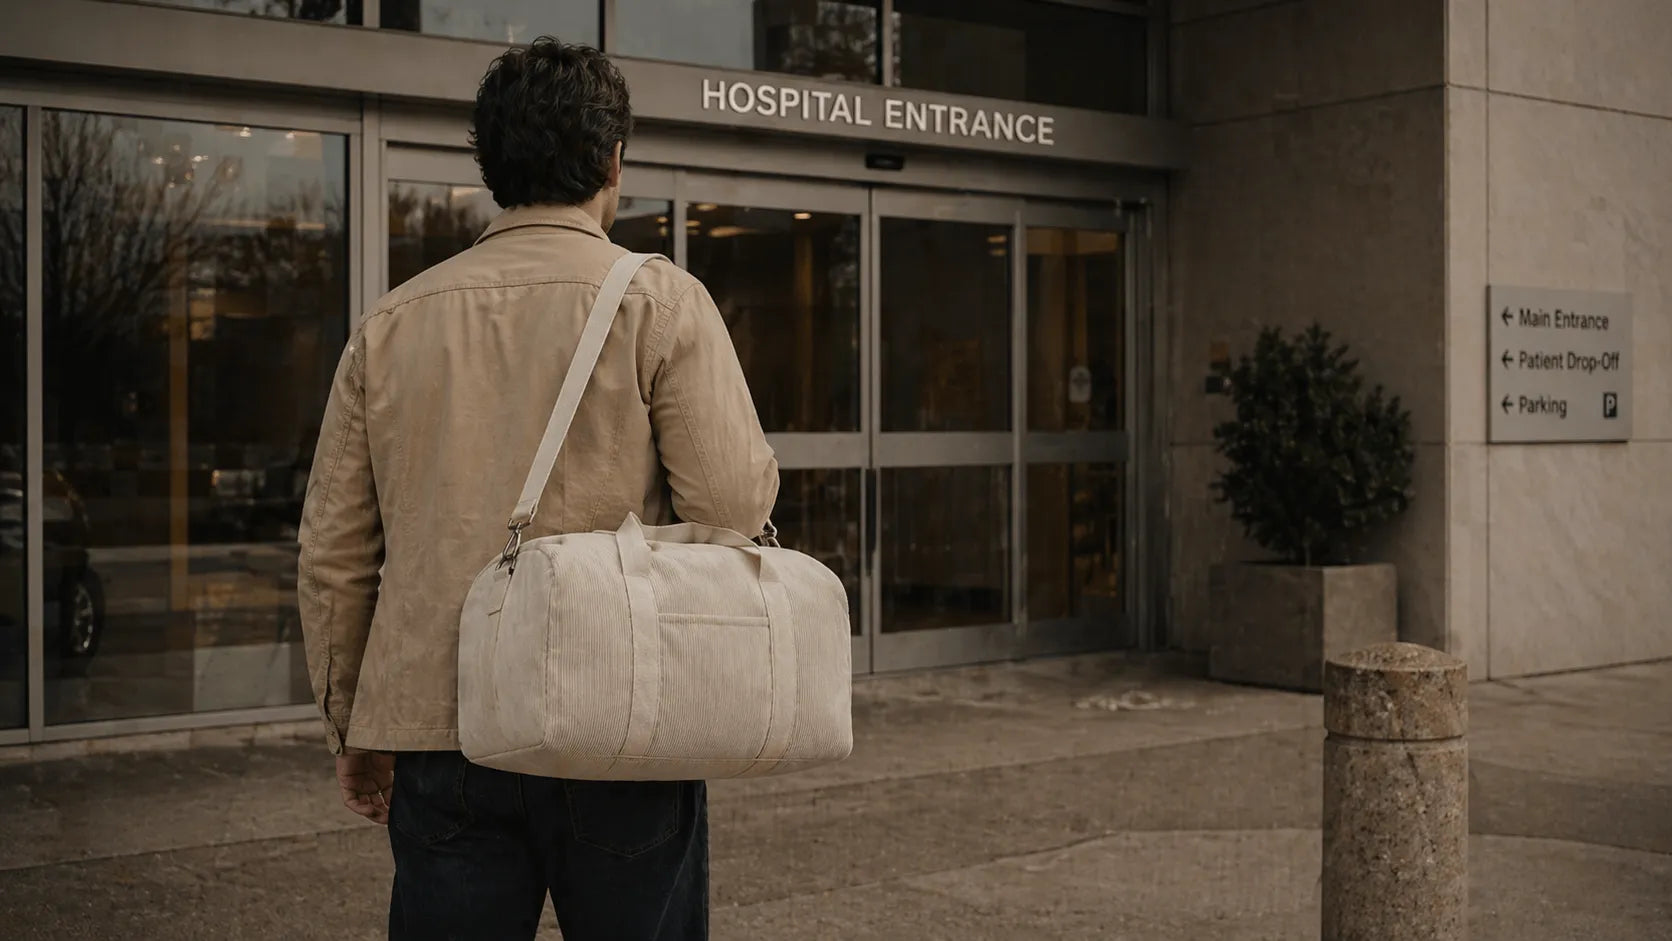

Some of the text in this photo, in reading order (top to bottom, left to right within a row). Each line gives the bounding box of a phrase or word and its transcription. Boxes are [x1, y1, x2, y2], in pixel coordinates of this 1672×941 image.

[702, 79, 1055, 145] HOSPITAL ENTRANCE
[1519, 308, 1609, 330] Main Entrance
[1519, 351, 1620, 374] Patient Drop-Off
[1519, 395, 1567, 419] Parking
[1605, 393, 1616, 417] P
